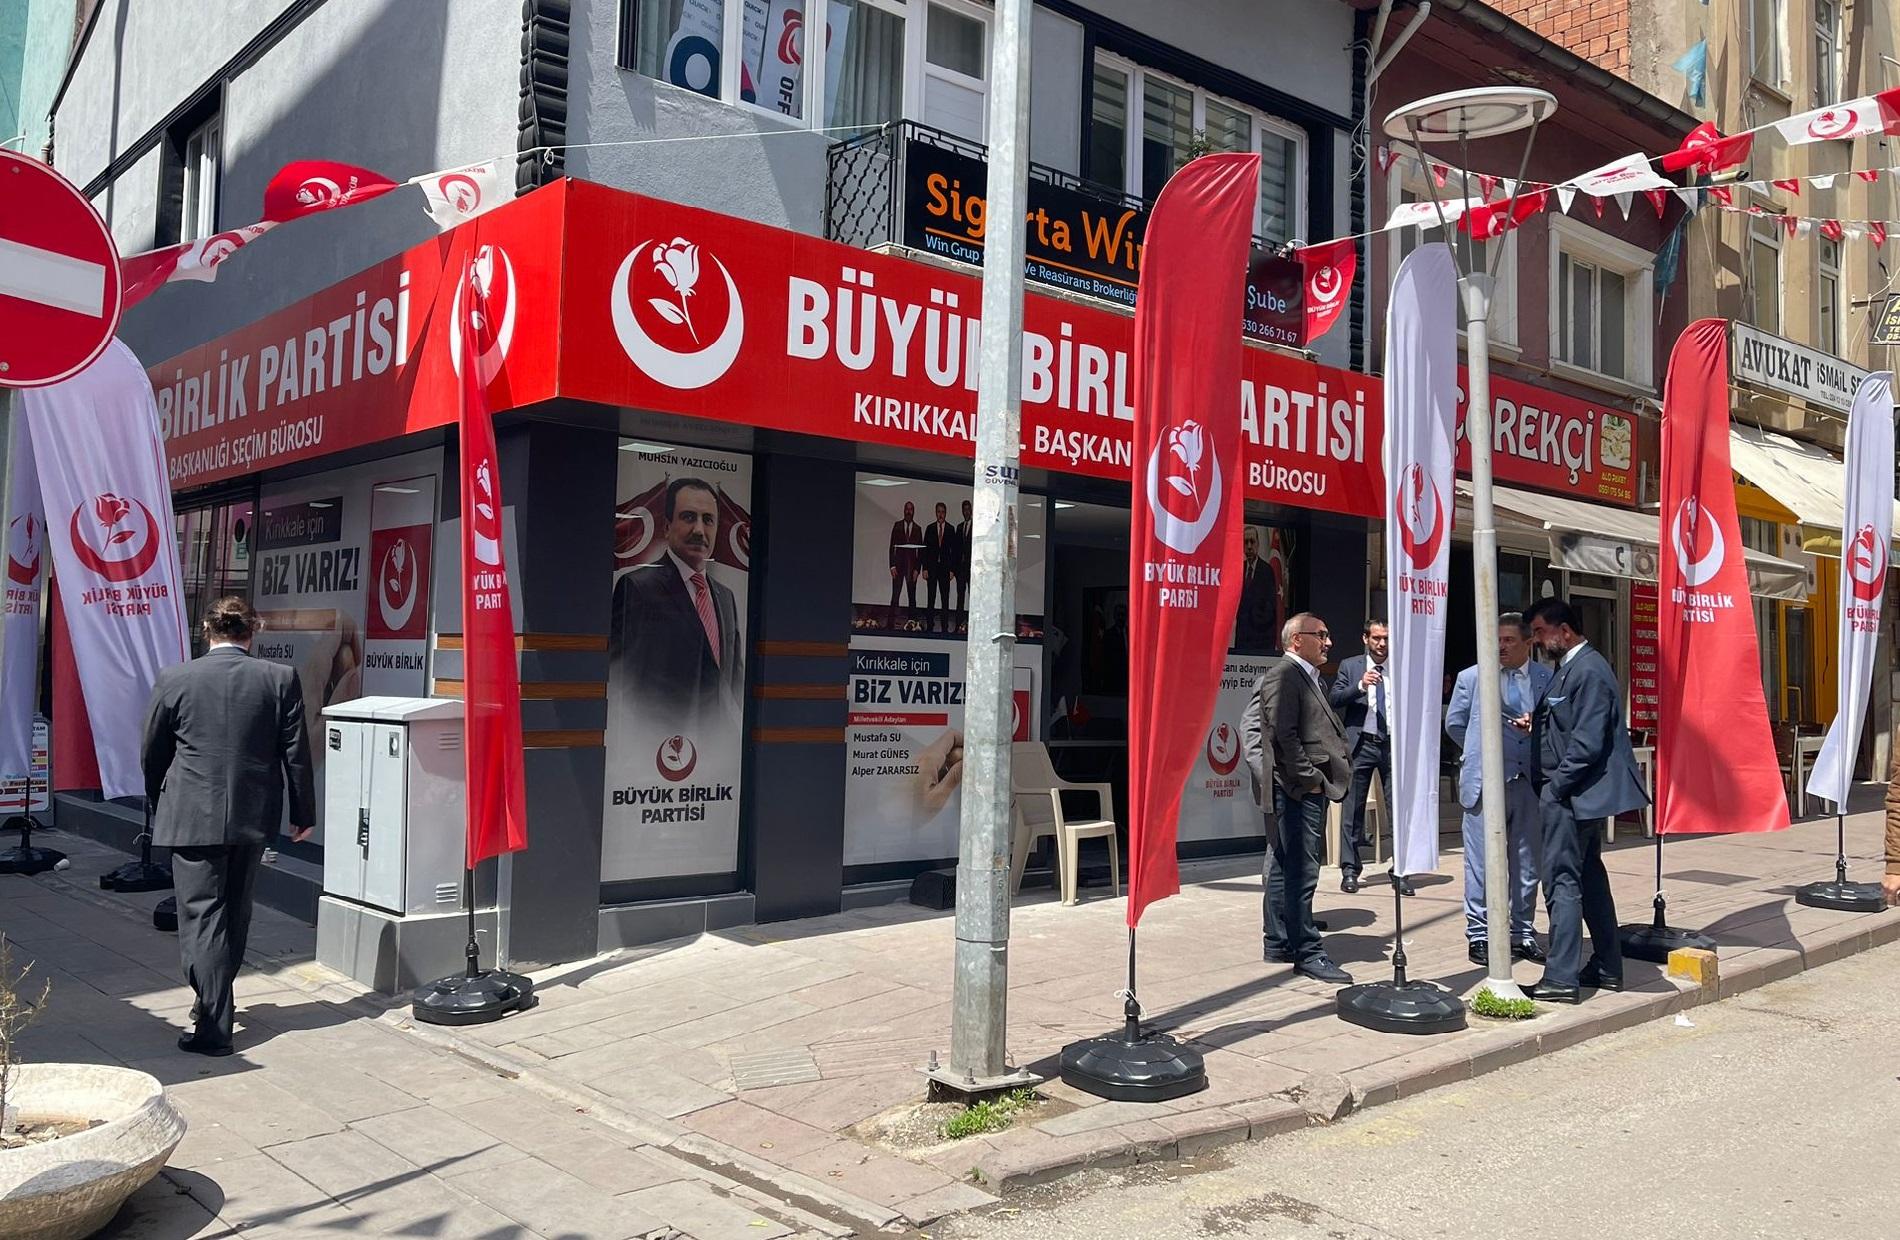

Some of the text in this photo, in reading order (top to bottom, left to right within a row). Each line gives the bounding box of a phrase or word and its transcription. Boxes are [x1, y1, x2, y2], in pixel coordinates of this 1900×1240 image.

[925, 234, 949, 251] Win
[951, 243, 980, 262] Grup
[1039, 265, 1092, 291] Reasürans
[1247, 284, 1286, 314] Şube
[258, 270, 411, 412] PARTİSİ
[1259, 323, 1275, 339] 266
[1276, 328, 1286, 341] 71
[1287, 330, 1298, 343] 67
[1741, 337, 1812, 390] AVUKAT
[169, 414, 324, 481] BAŞKANLIĞI SEÇİM BÜROSU
[1249, 459, 1327, 497] BÜROSU
[295, 546, 361, 594] VARIZ!
[1418, 576, 1448, 598] BİRLİK
[1688, 590, 1735, 609] BİRLİK
[283, 644, 294, 660] SU
[365, 649, 424, 671] BÜYÜK BİRLİK
[856, 655, 930, 675] Kırıkkale için
[853, 732, 901, 743] Mustafa SU
[852, 749, 879, 760] Murat
[851, 765, 920, 778] Alper ZARARSIZ
[612, 783, 733, 806] BÜYÜK BİRLİK
[641, 803, 706, 824] PARTİSİ
